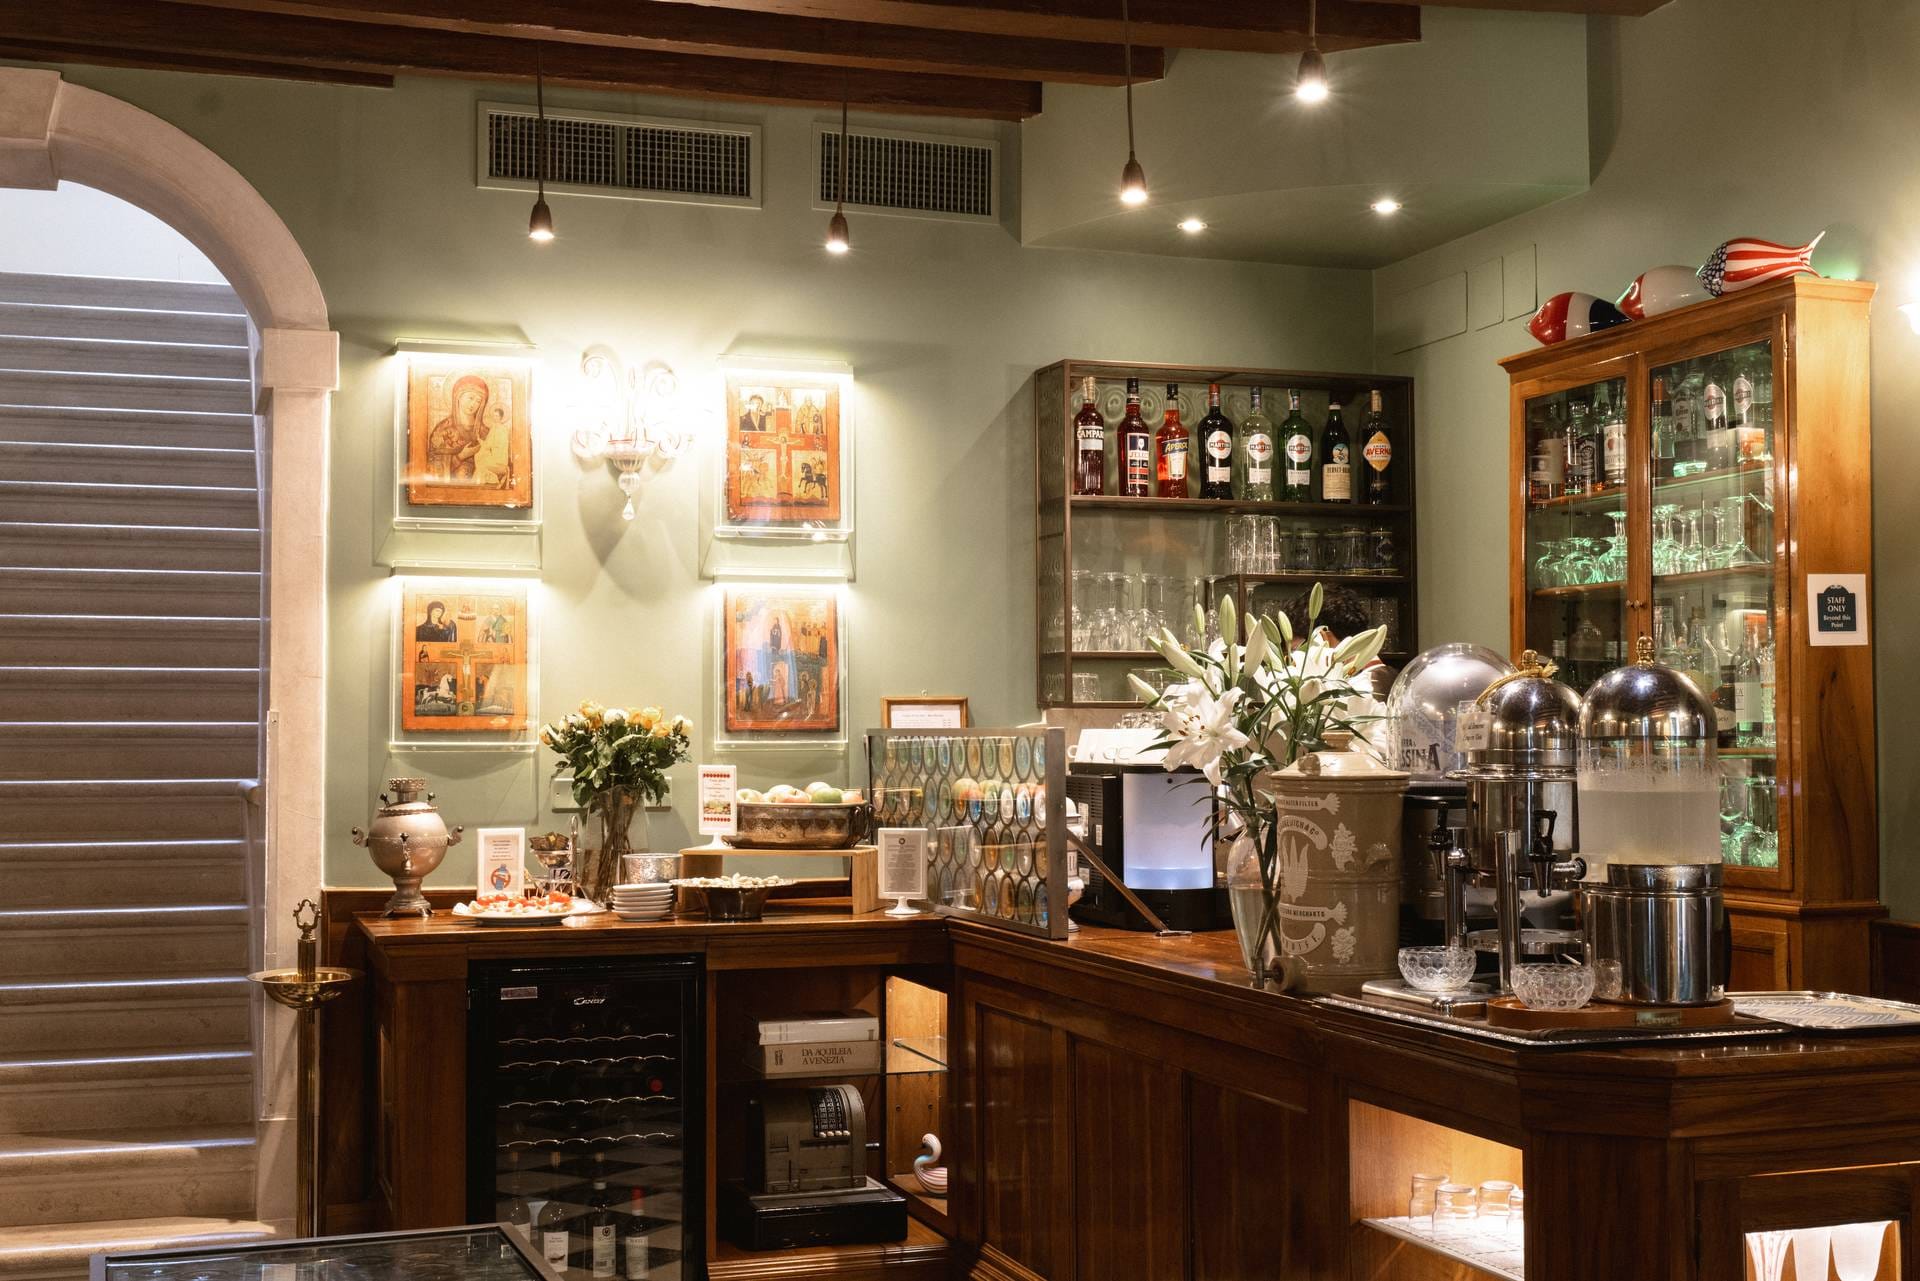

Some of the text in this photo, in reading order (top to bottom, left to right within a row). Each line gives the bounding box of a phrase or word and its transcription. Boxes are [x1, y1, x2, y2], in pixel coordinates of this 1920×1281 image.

[1826, 596, 1846, 604] STAFF
[801, 1047, 853, 1058] DA AQUILEIA
[809, 1055, 845, 1064] VENEZIA
